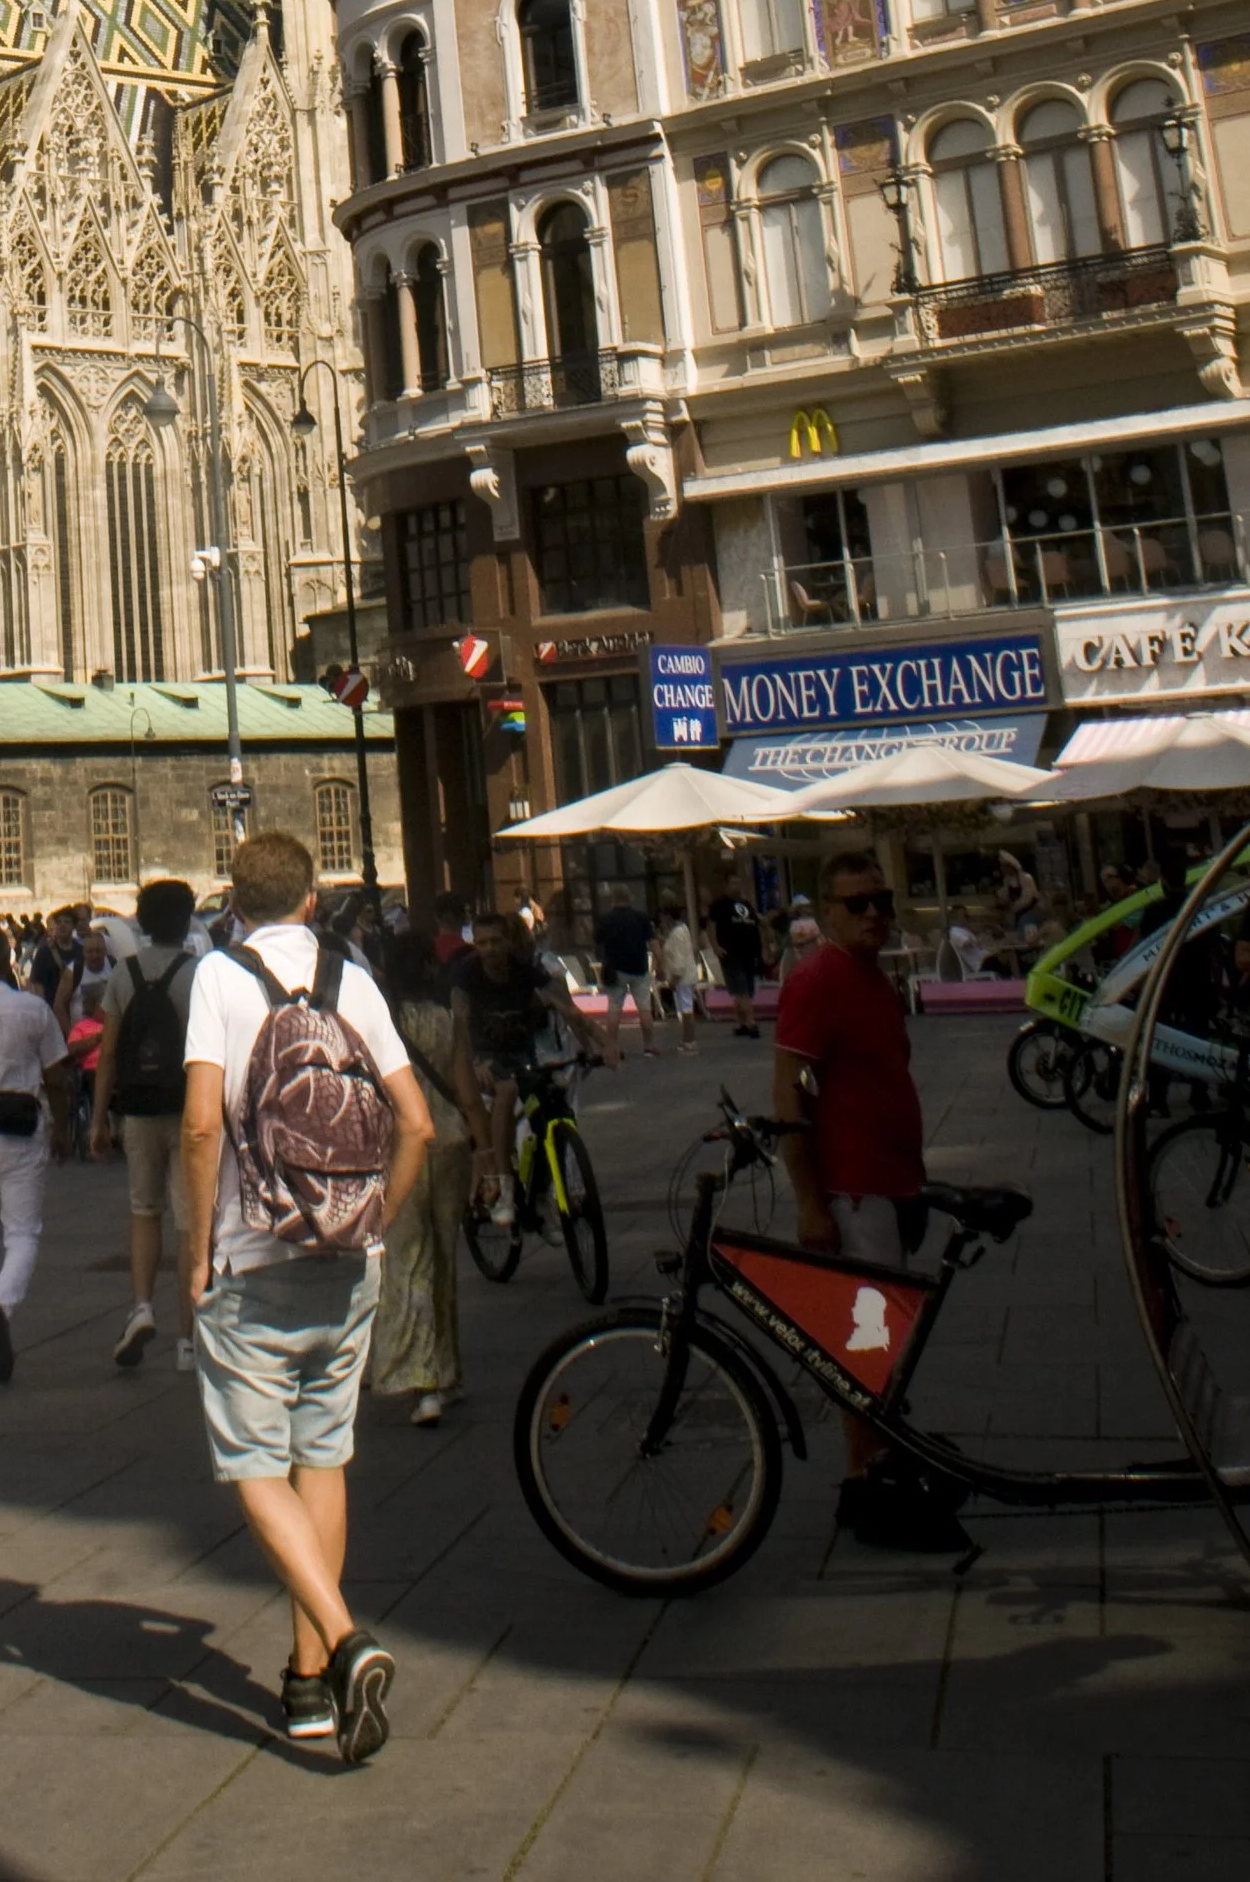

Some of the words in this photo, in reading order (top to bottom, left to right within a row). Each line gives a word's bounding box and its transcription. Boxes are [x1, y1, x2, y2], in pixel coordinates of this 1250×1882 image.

[657, 654, 705, 675] CAMBIO
[653, 683, 714, 709] CHANGE
[722, 668, 841, 724] MONEY
[849, 647, 1046, 715] EXCHANGE
[753, 746, 802, 768] THE
[936, 730, 1017, 756] ROUP
